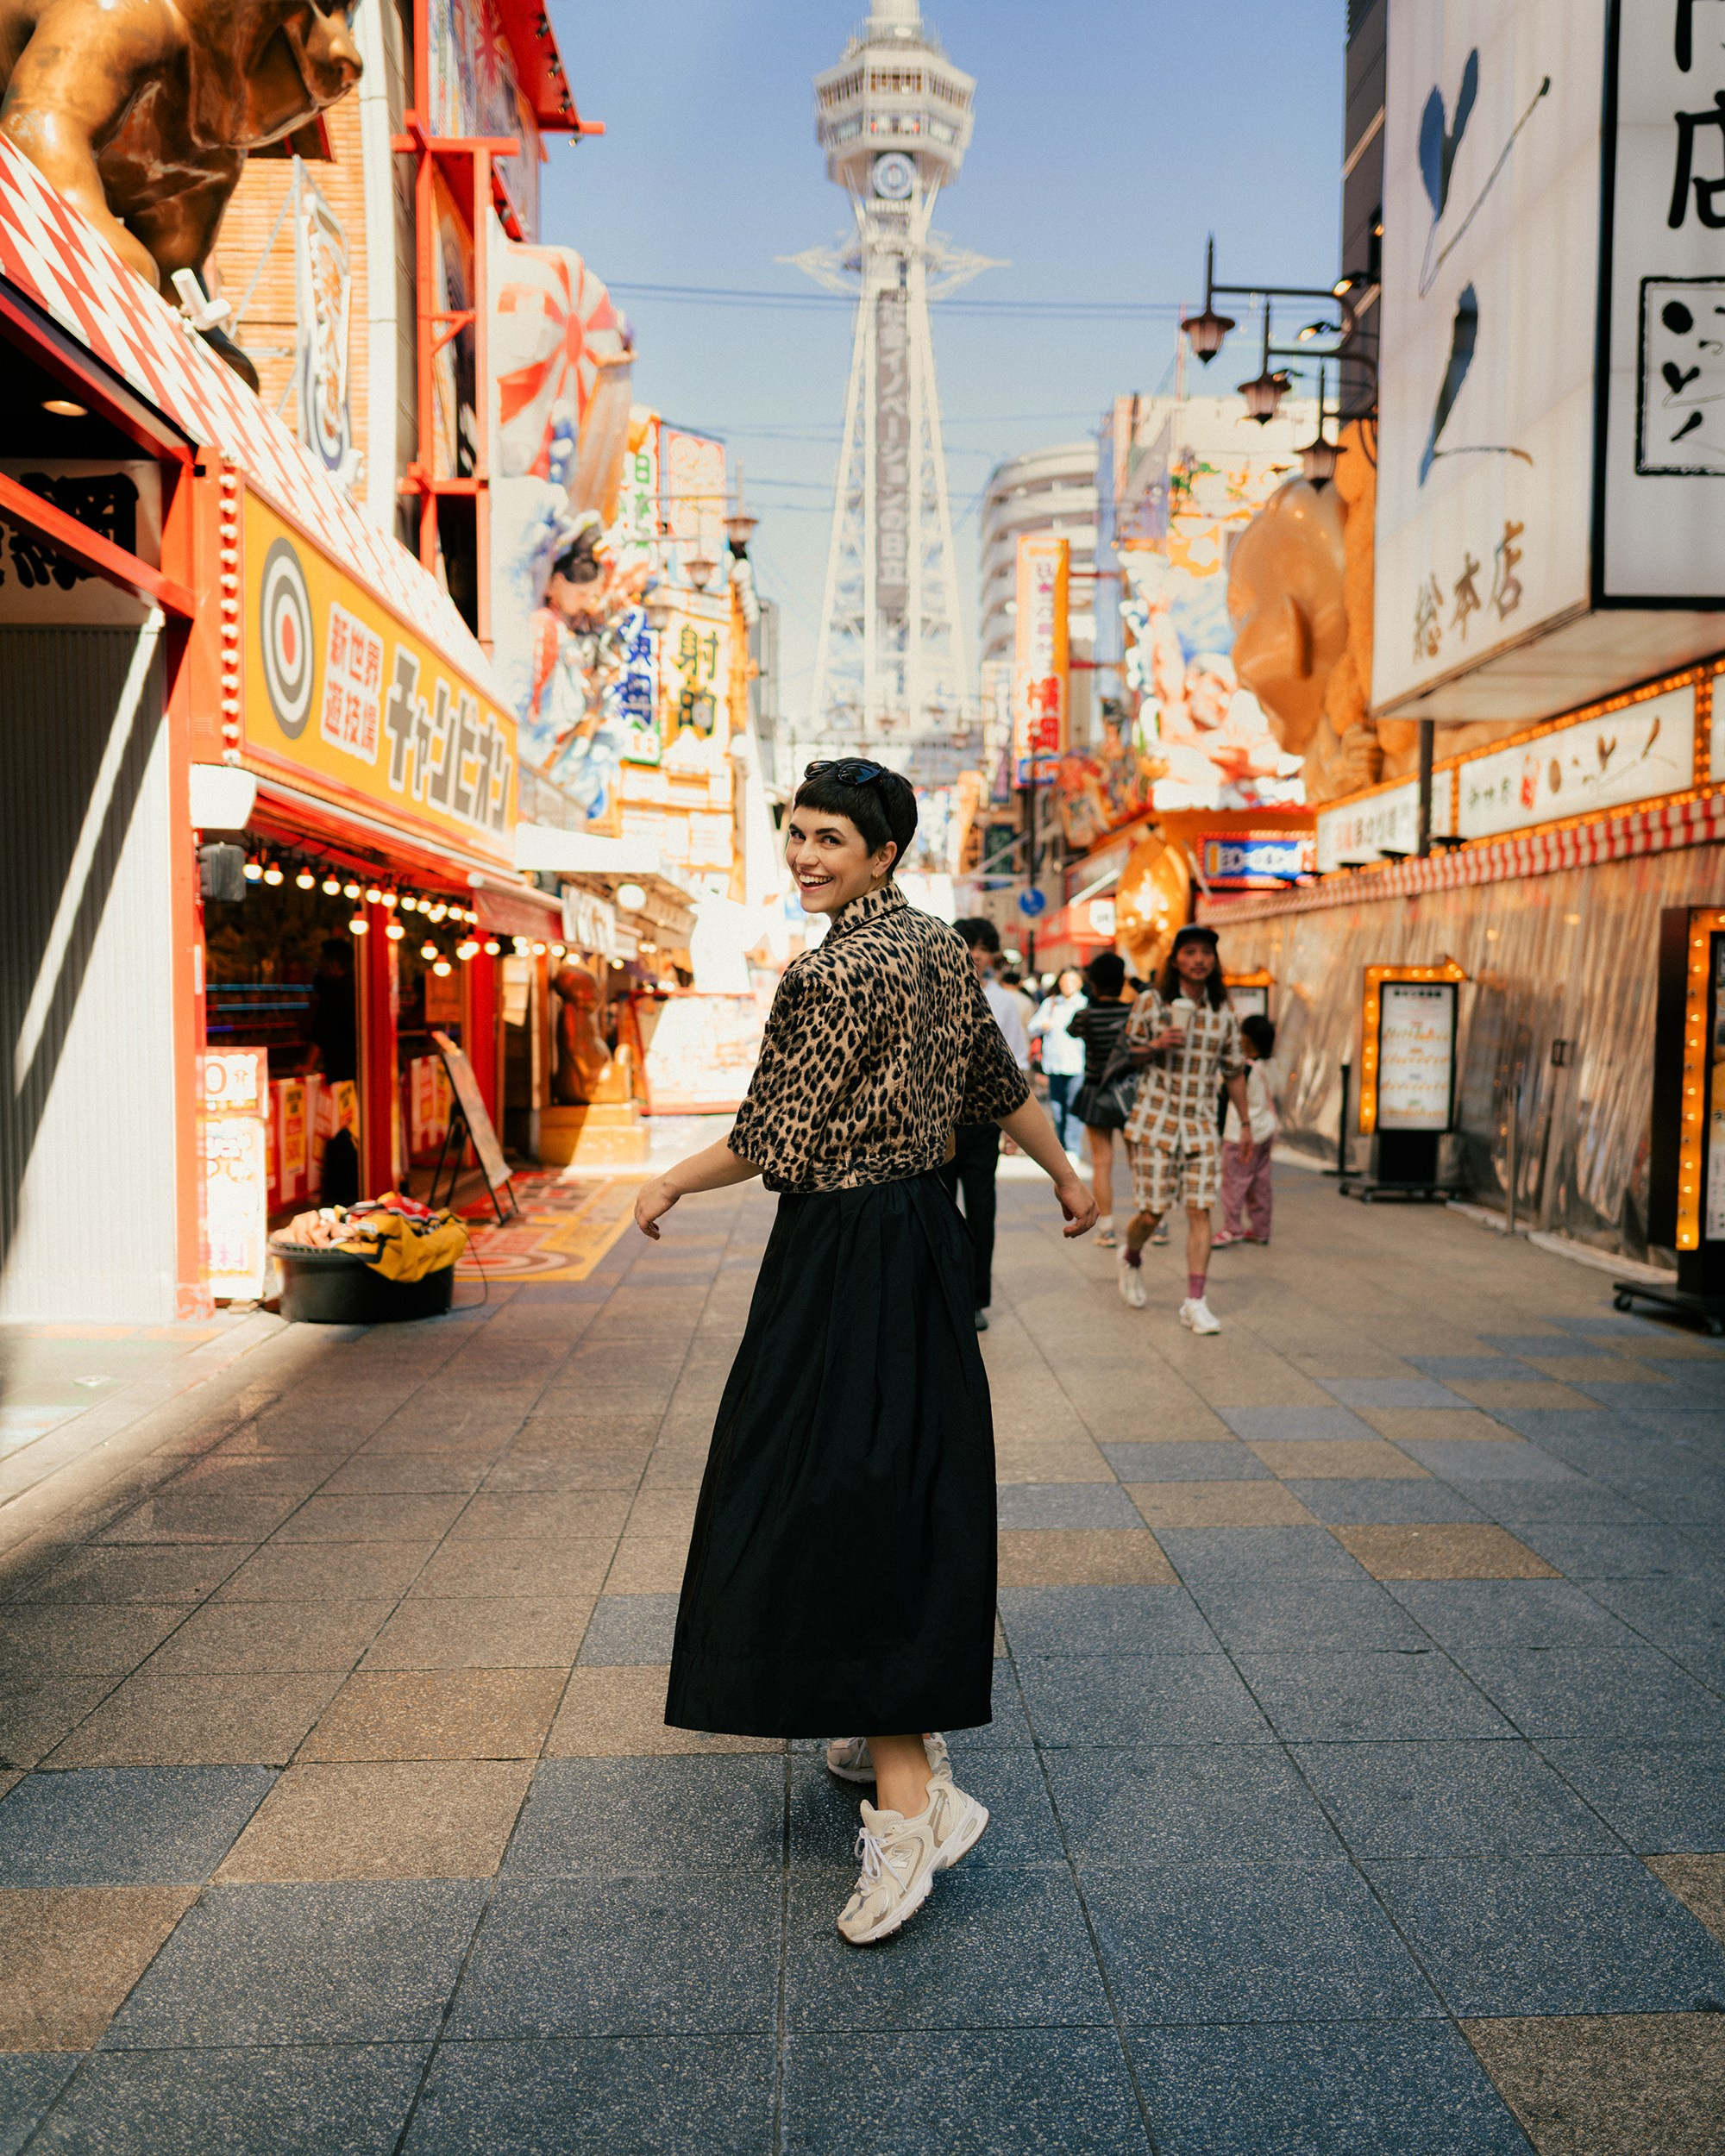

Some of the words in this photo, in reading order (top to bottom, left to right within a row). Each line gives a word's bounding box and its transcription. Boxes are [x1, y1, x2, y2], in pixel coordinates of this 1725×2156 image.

[388, 650, 511, 833] チャンピオン
[670, 625, 718, 736] 射的
